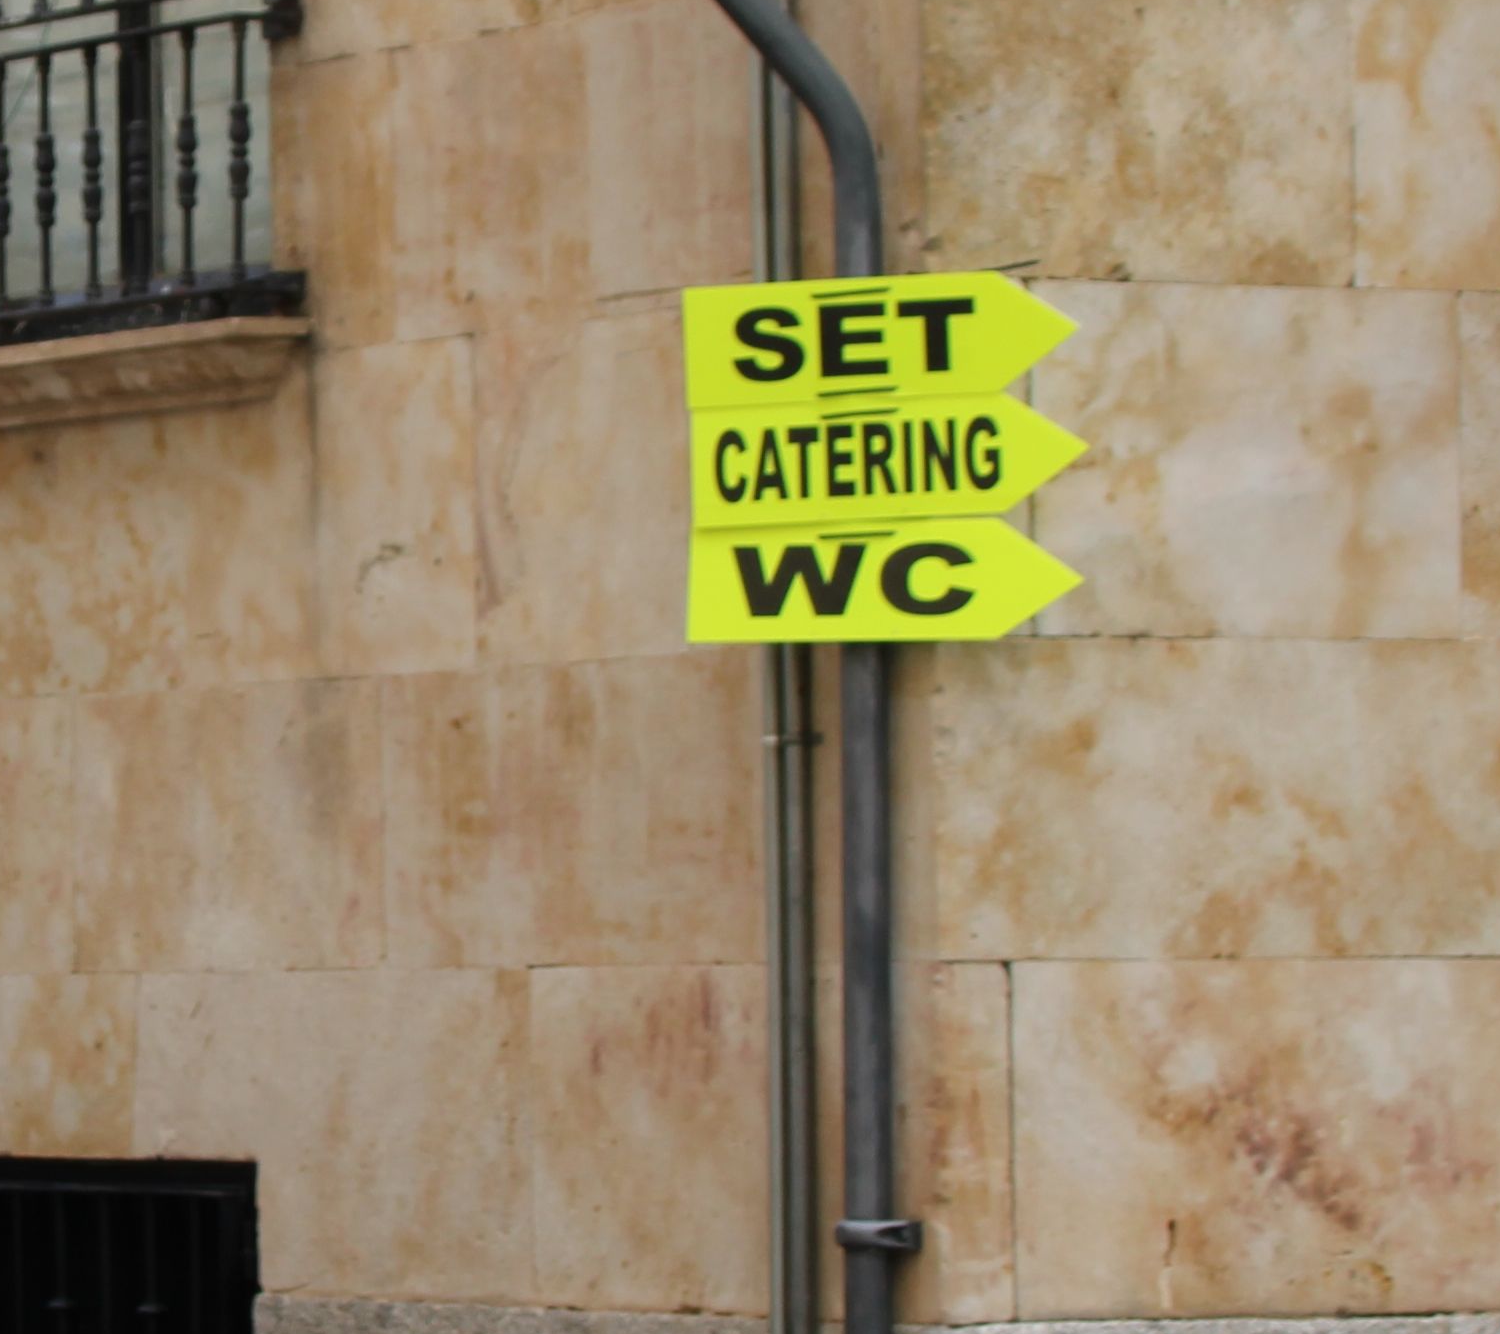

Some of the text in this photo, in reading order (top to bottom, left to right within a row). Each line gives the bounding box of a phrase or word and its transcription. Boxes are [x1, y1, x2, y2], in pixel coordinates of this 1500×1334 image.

[732, 296, 975, 382] SET
[714, 414, 1003, 504] CATERING
[732, 542, 977, 618] WC
